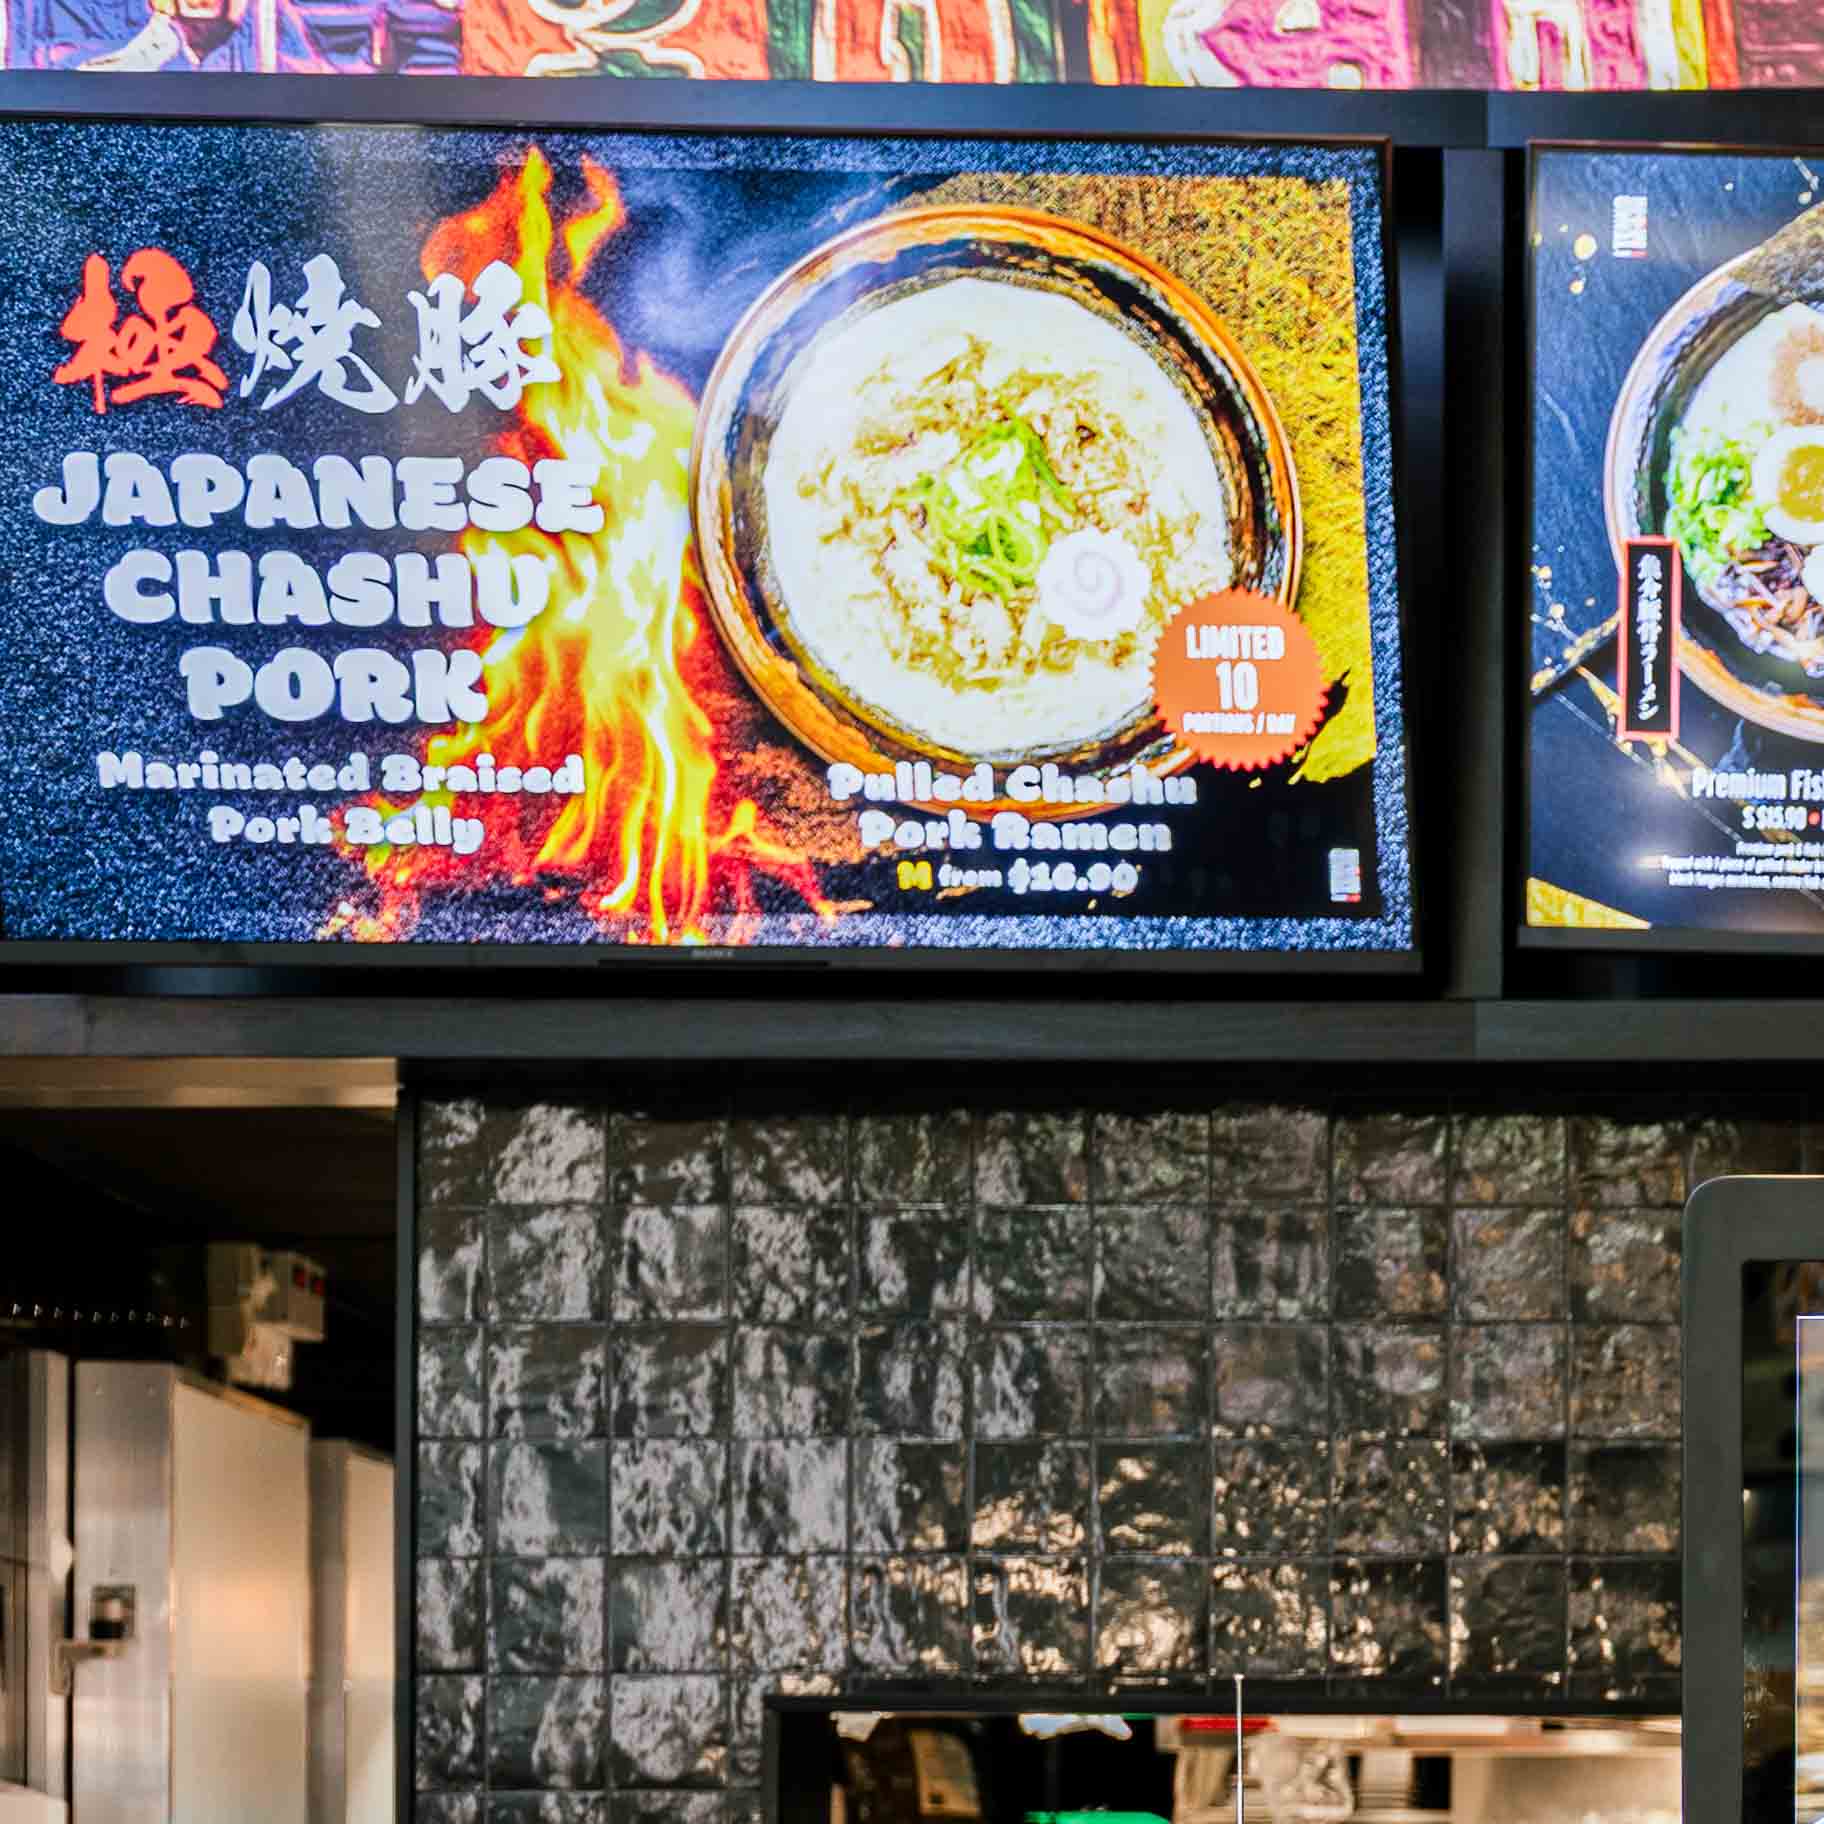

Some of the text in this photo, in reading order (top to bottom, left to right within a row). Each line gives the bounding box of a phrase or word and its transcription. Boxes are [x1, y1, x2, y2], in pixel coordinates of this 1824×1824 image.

[32, 452, 605, 534] JAPANESE
[104, 548, 551, 628] CHASHU
[181, 646, 489, 724] PORK
[1215, 661, 1260, 711] 10
[96, 750, 586, 795] Marinated Braised
[827, 761, 1198, 805] Pulled Chashu
[1692, 768, 1787, 799] Premium
[208, 805, 485, 855] Pork Belly
[858, 809, 1172, 852] Pork Ramen
